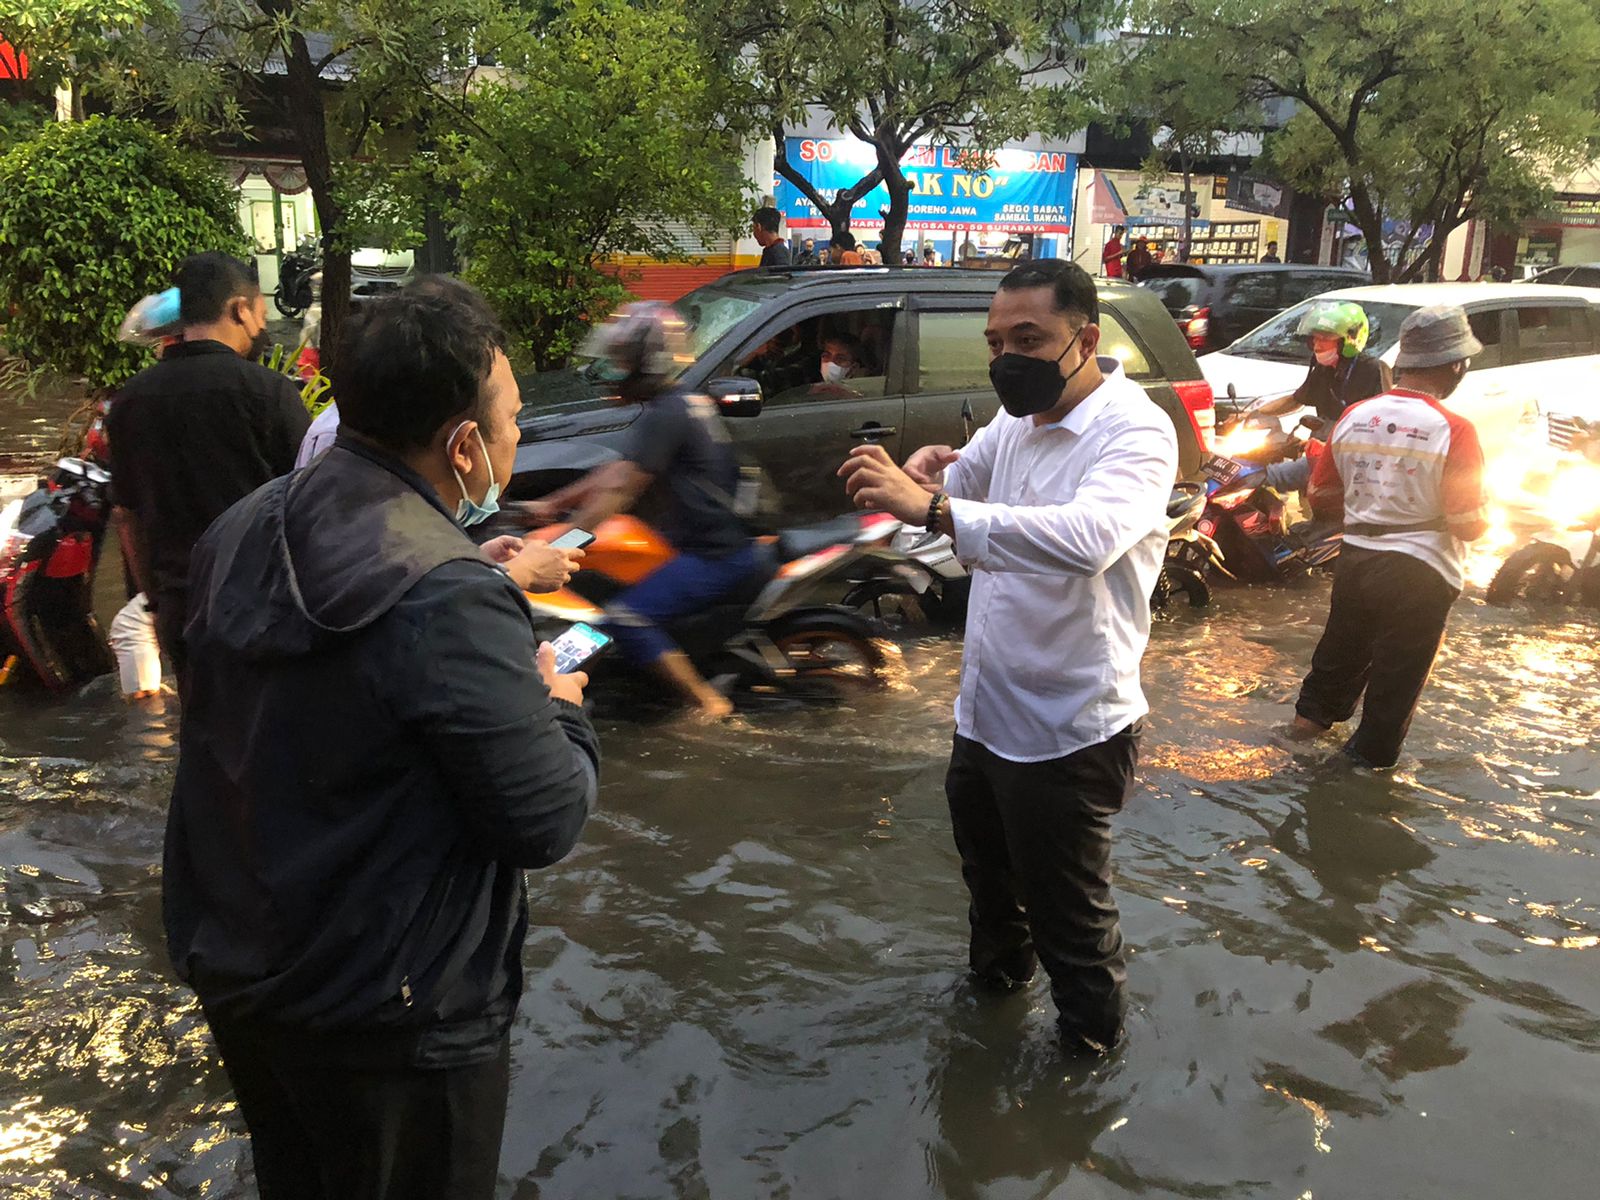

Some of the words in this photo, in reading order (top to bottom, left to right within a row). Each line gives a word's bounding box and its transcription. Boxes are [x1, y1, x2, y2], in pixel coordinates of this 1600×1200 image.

[949, 207, 977, 216] JAWA
[1002, 204, 1030, 213] SEGO
[1032, 205, 1065, 214] BABAT
[994, 213, 1031, 222] SAMBAL
[986, 224, 1045, 232] SURABAYA
